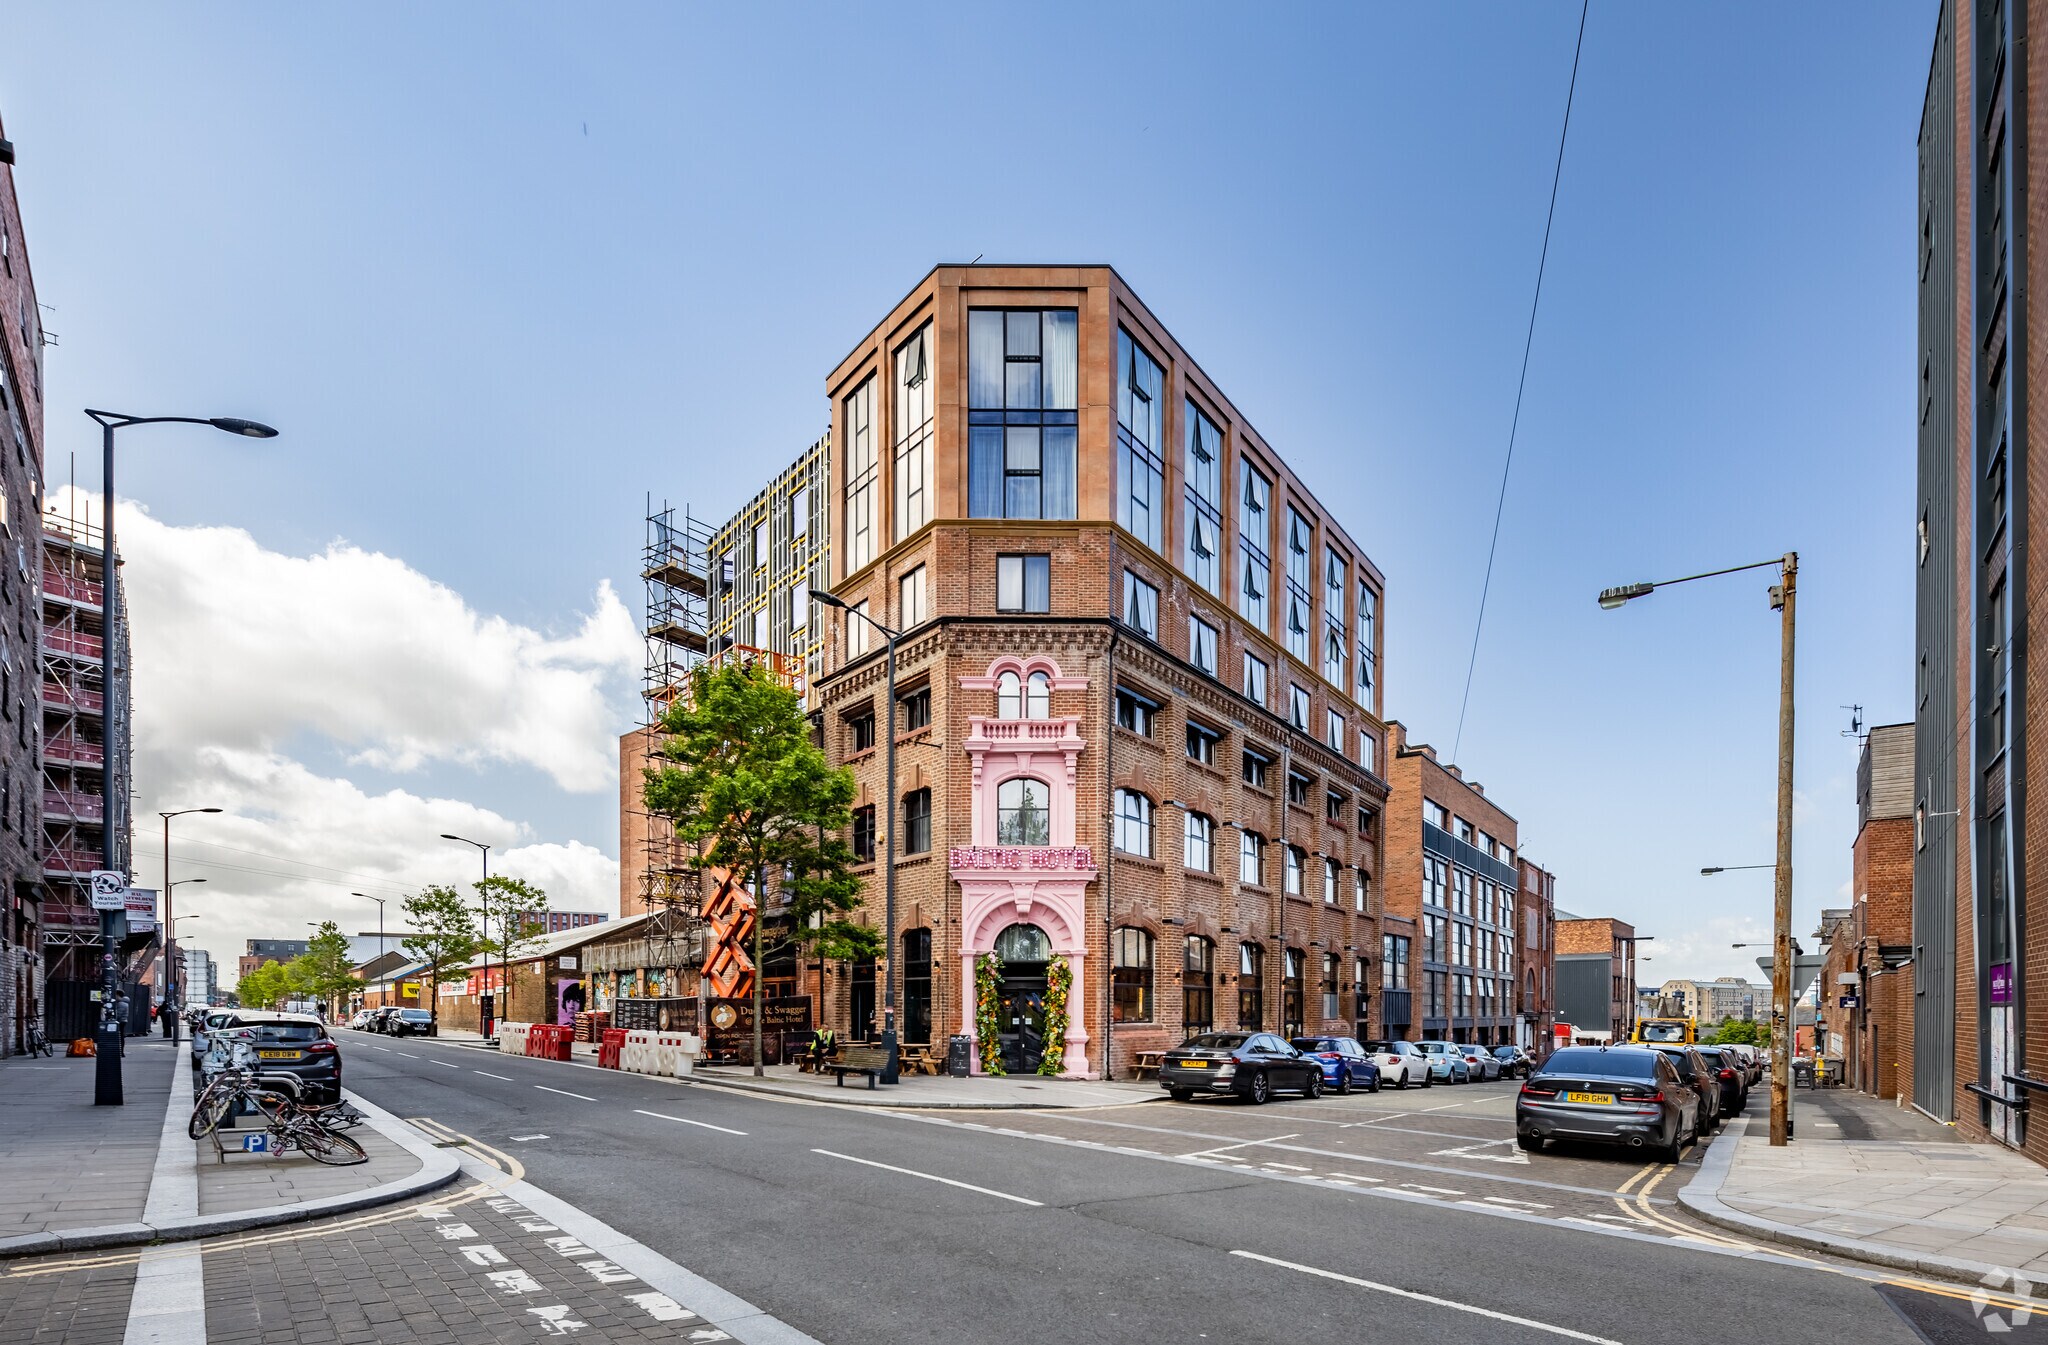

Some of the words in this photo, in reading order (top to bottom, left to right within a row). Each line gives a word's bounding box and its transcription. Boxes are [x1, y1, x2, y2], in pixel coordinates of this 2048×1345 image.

[950, 849, 1022, 868] BALTIC
[1029, 849, 1098, 868] HOTEL
[774, 1006, 806, 1015] Swagger
[766, 1016, 785, 1024] Baltic
[785, 1015, 804, 1023] Hotel
